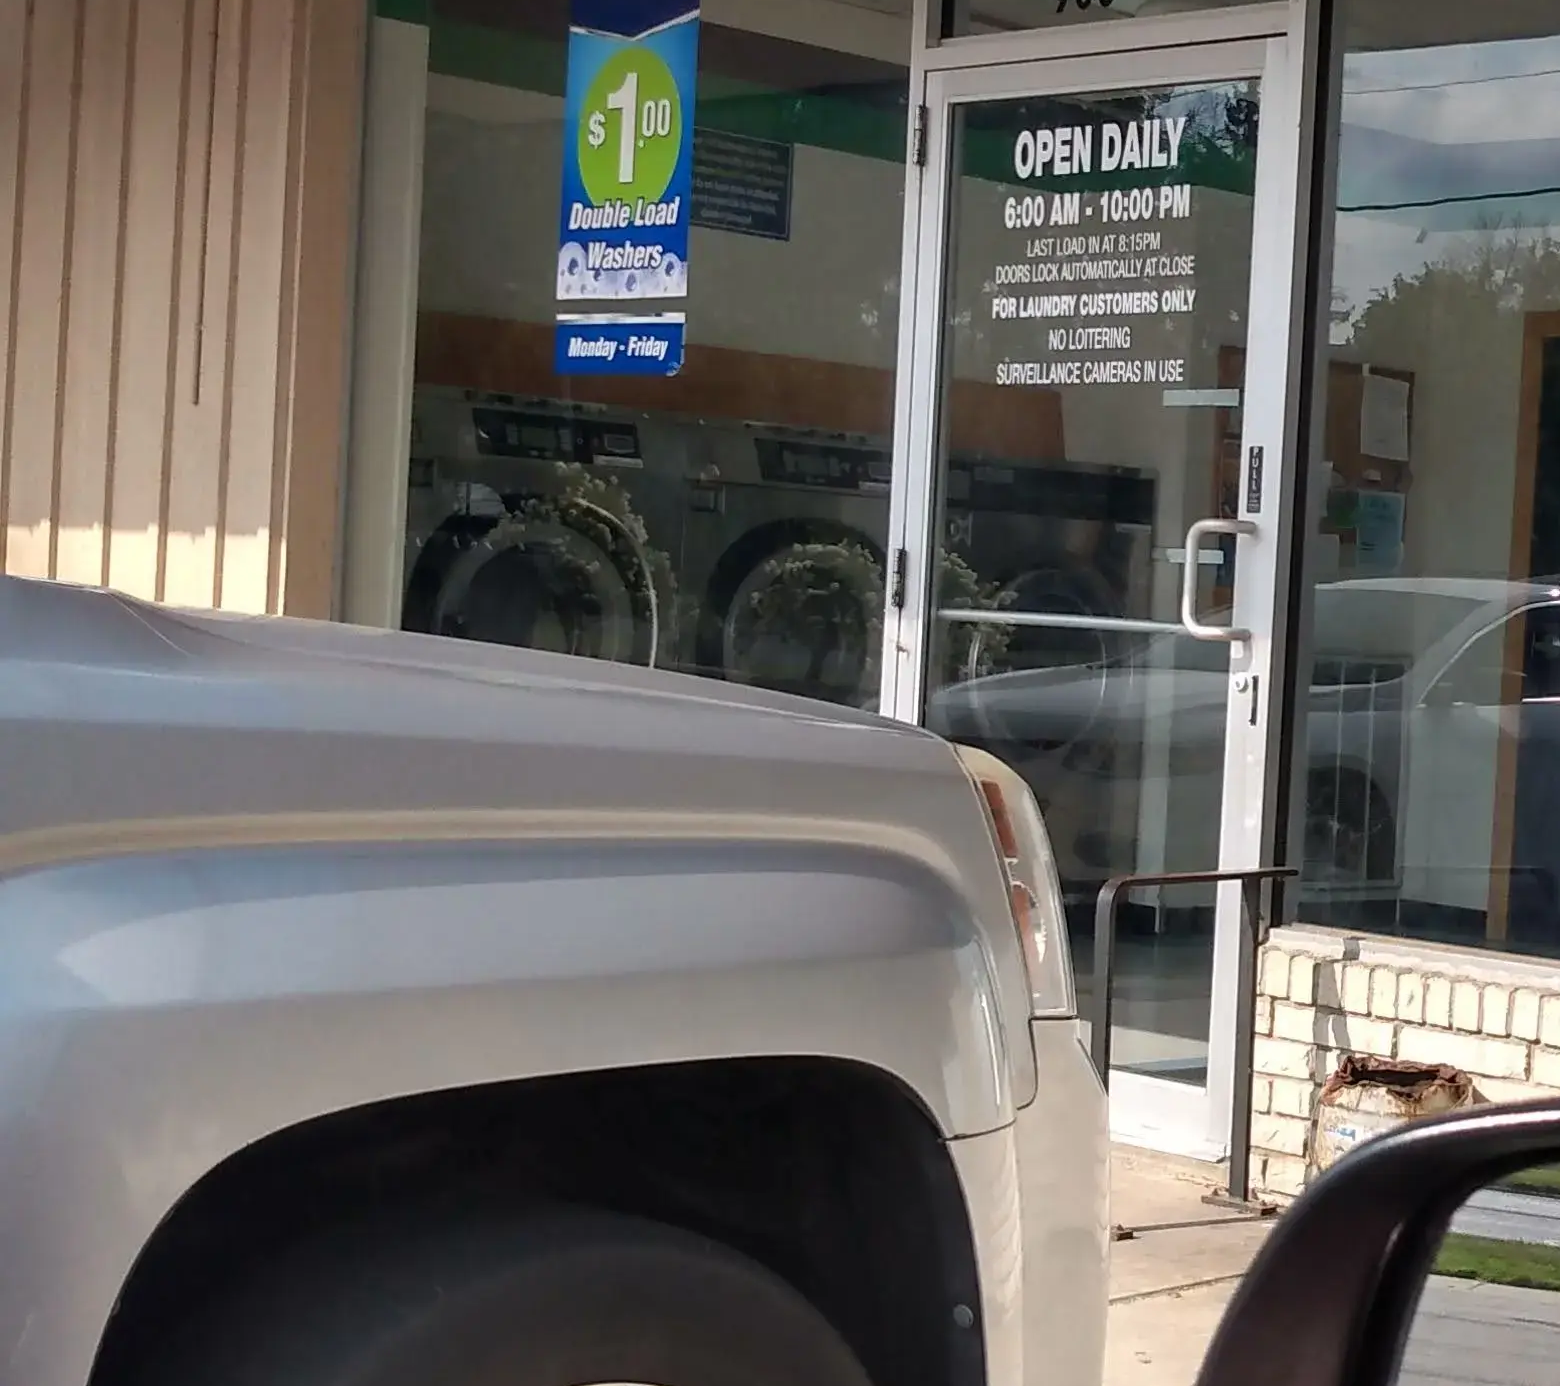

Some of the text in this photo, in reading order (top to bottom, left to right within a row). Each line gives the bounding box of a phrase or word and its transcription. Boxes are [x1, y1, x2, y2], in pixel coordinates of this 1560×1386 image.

[1014, 117, 1186, 179] OPEN DAILY
[568, 196, 680, 230] Double Load
[1004, 196, 1045, 229] 6:00
[1049, 192, 1080, 226] AM
[1100, 188, 1153, 223] 10:00
[1159, 184, 1191, 219] PM
[587, 240, 663, 270] Washers
[1027, 232, 1161, 257] LAST LOAD IN AT 8:15PM
[995, 255, 1196, 284] DOORS LOCK AUTOMATICALLY AT CLOSE
[991, 289, 1196, 319] FOR LAUNDRY CUSTOMERS ONLY
[568, 337, 617, 361] Monday
[627, 336, 668, 361] Friday
[1048, 326, 1131, 351] NO LOITERING
[996, 359, 1184, 385] SURVEILLANCE CAMERAS IN USE
[1251, 447, 1260, 490] PULL
